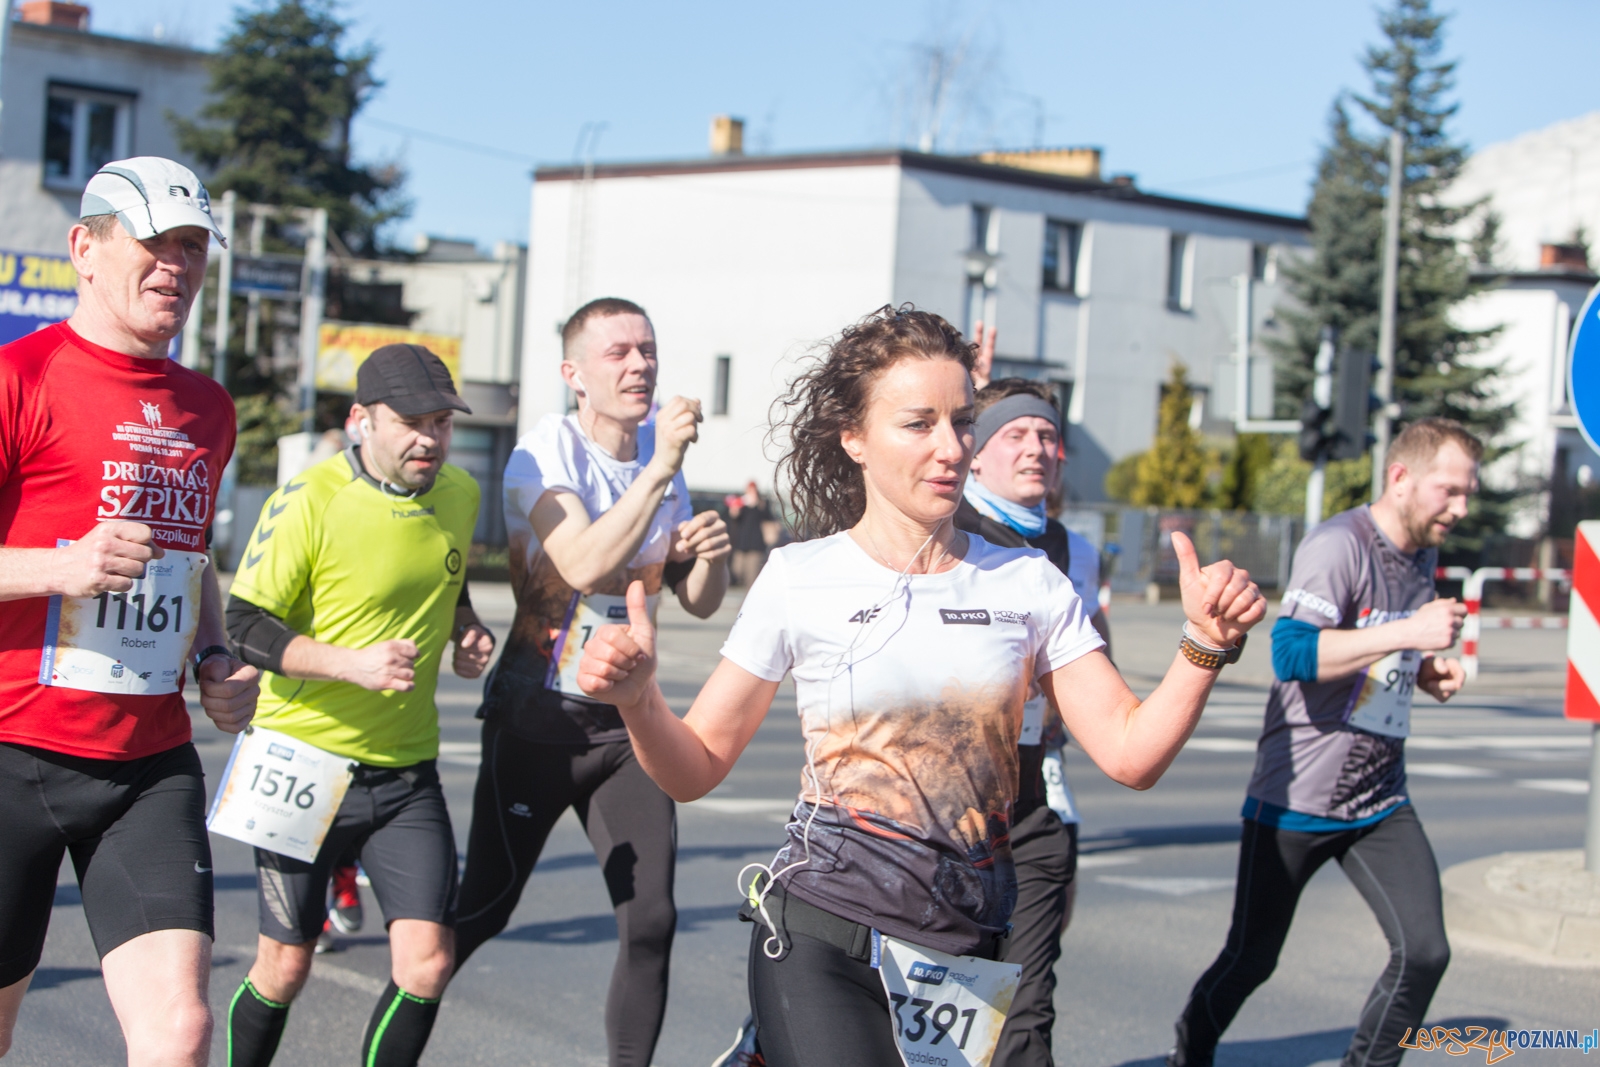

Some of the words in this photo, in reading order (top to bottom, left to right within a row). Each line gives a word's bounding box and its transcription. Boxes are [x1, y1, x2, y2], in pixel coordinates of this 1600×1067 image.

[102, 460, 198, 490] DRUŻYNA
[98, 485, 210, 524] SZPIKU
[93, 591, 183, 633] 11161
[121, 637, 157, 649] Robert
[250, 764, 317, 810] 1516
[925, 968, 945, 981] PKO
